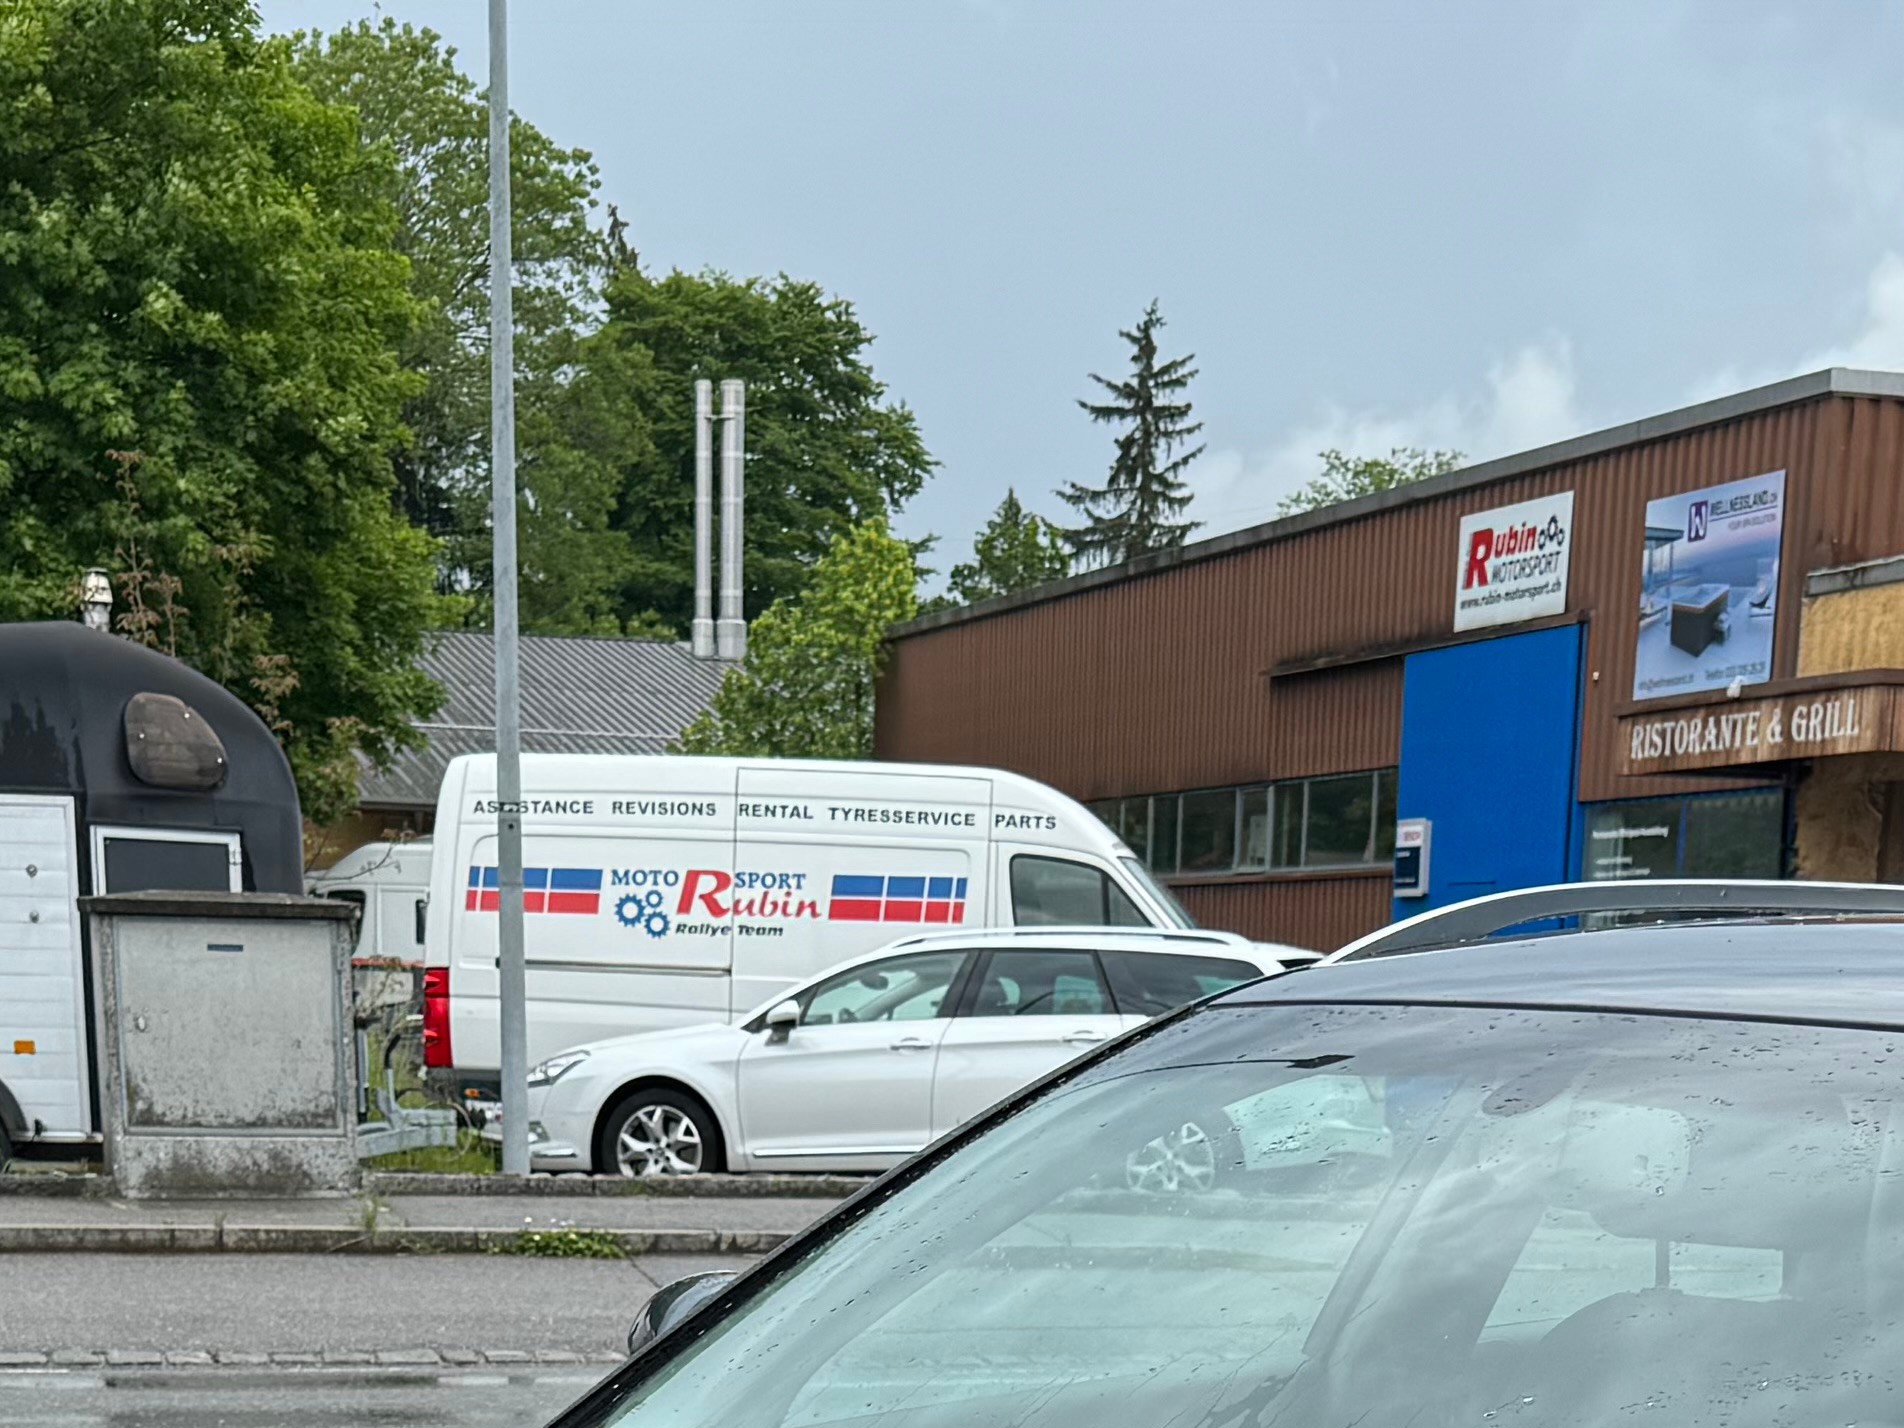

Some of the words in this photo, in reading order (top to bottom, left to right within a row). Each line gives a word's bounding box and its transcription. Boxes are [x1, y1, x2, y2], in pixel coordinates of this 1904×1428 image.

[1462, 521, 1537, 590] Rubin
[1491, 551, 1562, 584] MOTORSPORT
[1631, 711, 1761, 760] RISTORANTE
[1767, 707, 1784, 744] &
[1791, 698, 1860, 743] GRILL
[473, 799, 594, 815] ASSTANCE
[612, 801, 717, 816] REVISIONS
[739, 803, 814, 820] RENTAL
[828, 806, 976, 827] TYRESSERVICE
[995, 814, 1057, 830] PARTS
[611, 869, 679, 886] MOTO
[676, 869, 822, 918] Rubin
[675, 923, 732, 938] Rallye
[738, 924, 784, 937] Team
